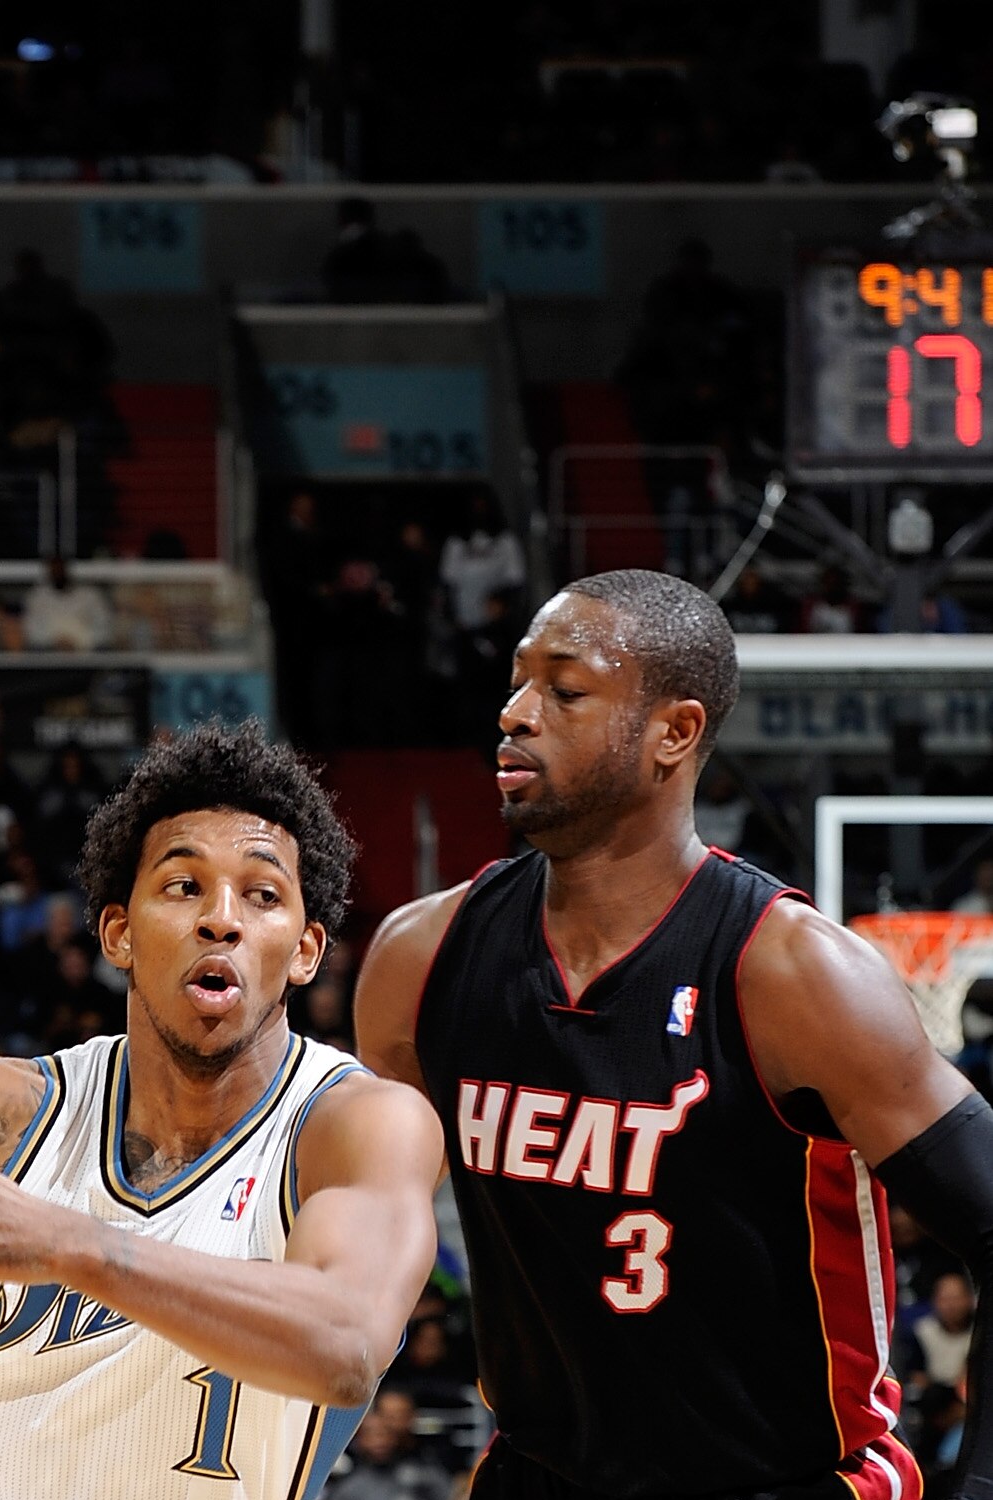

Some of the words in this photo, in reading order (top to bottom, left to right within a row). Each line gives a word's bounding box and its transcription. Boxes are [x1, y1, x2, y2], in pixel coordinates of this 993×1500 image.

[502, 206, 589, 252] 105
[885, 332, 983, 450] 17
[458, 1069, 710, 1197] HEAT
[602, 1209, 673, 1314] 3
[171, 1366, 242, 1481] 1
